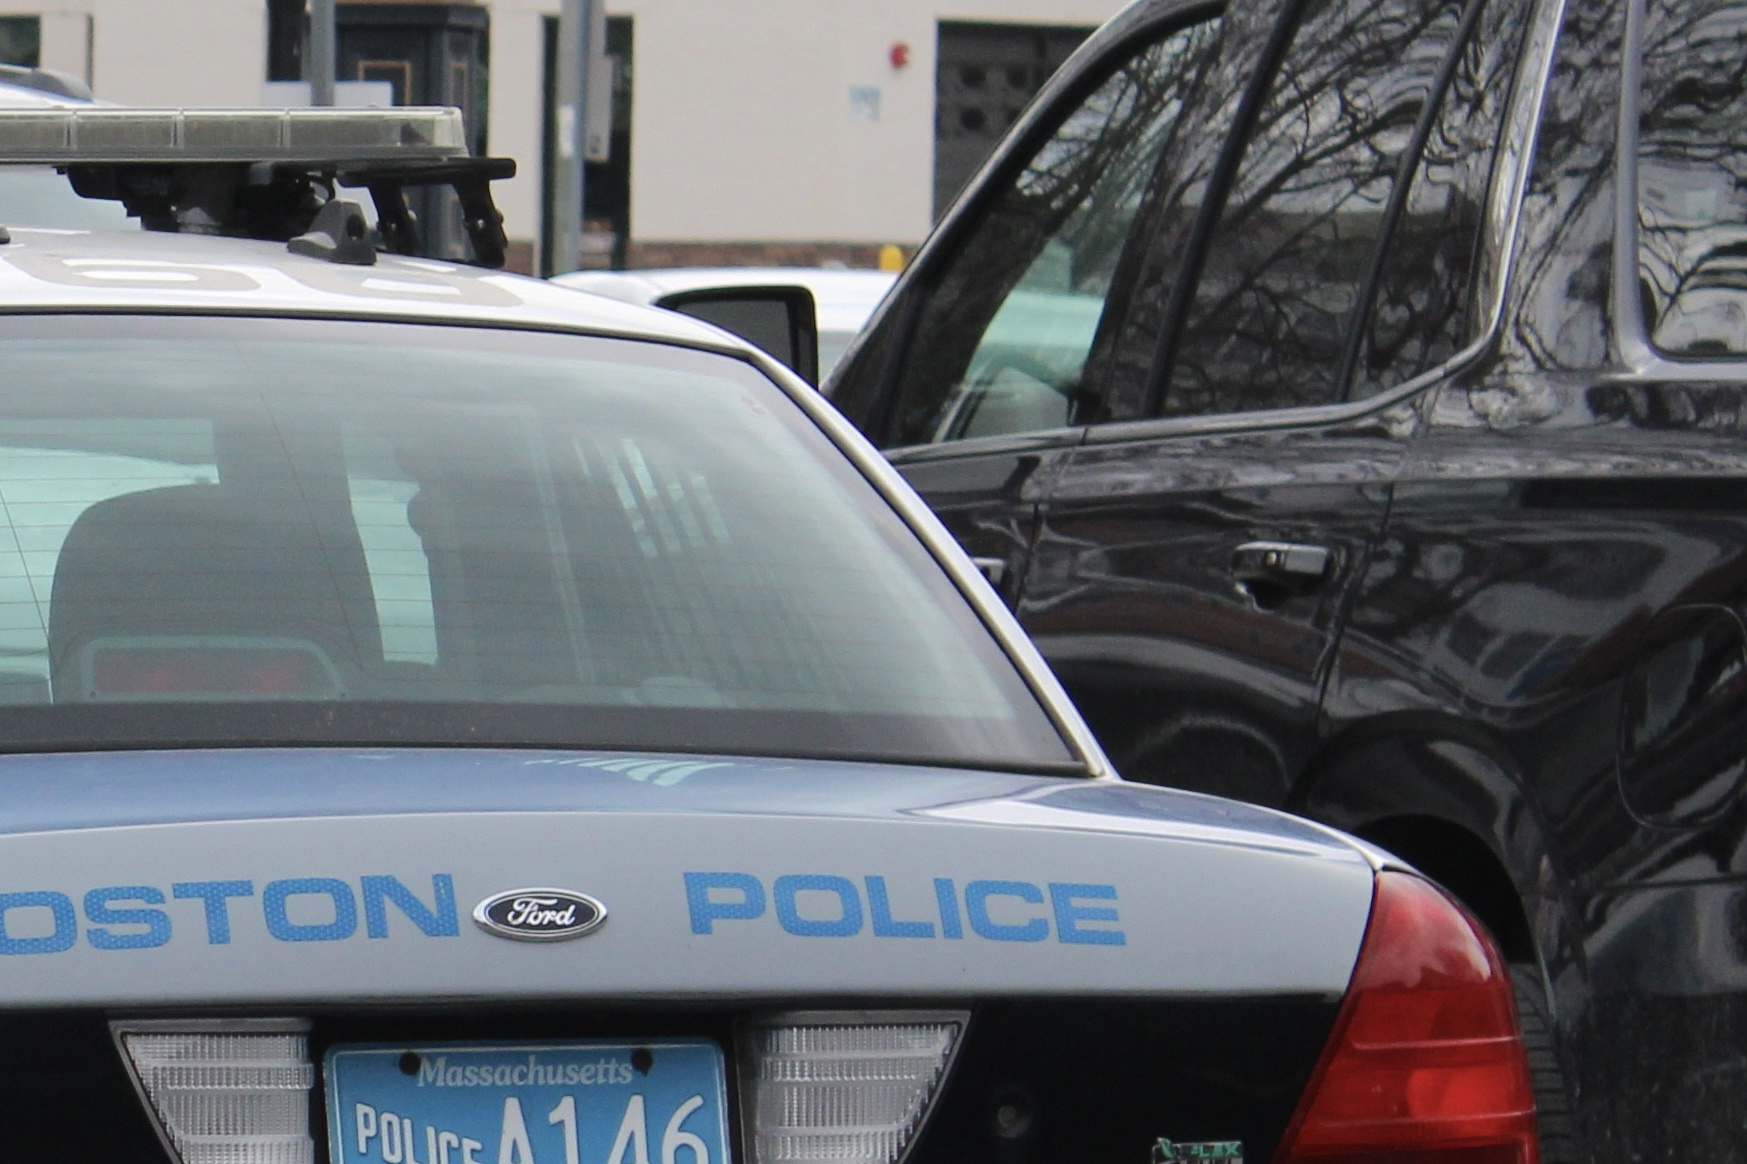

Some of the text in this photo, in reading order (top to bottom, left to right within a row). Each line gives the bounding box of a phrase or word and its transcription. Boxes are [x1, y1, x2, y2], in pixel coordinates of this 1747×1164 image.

[507, 897, 576, 926] Ford
[683, 871, 1127, 946] POLICE
[417, 1054, 634, 1088] Massachusetts
